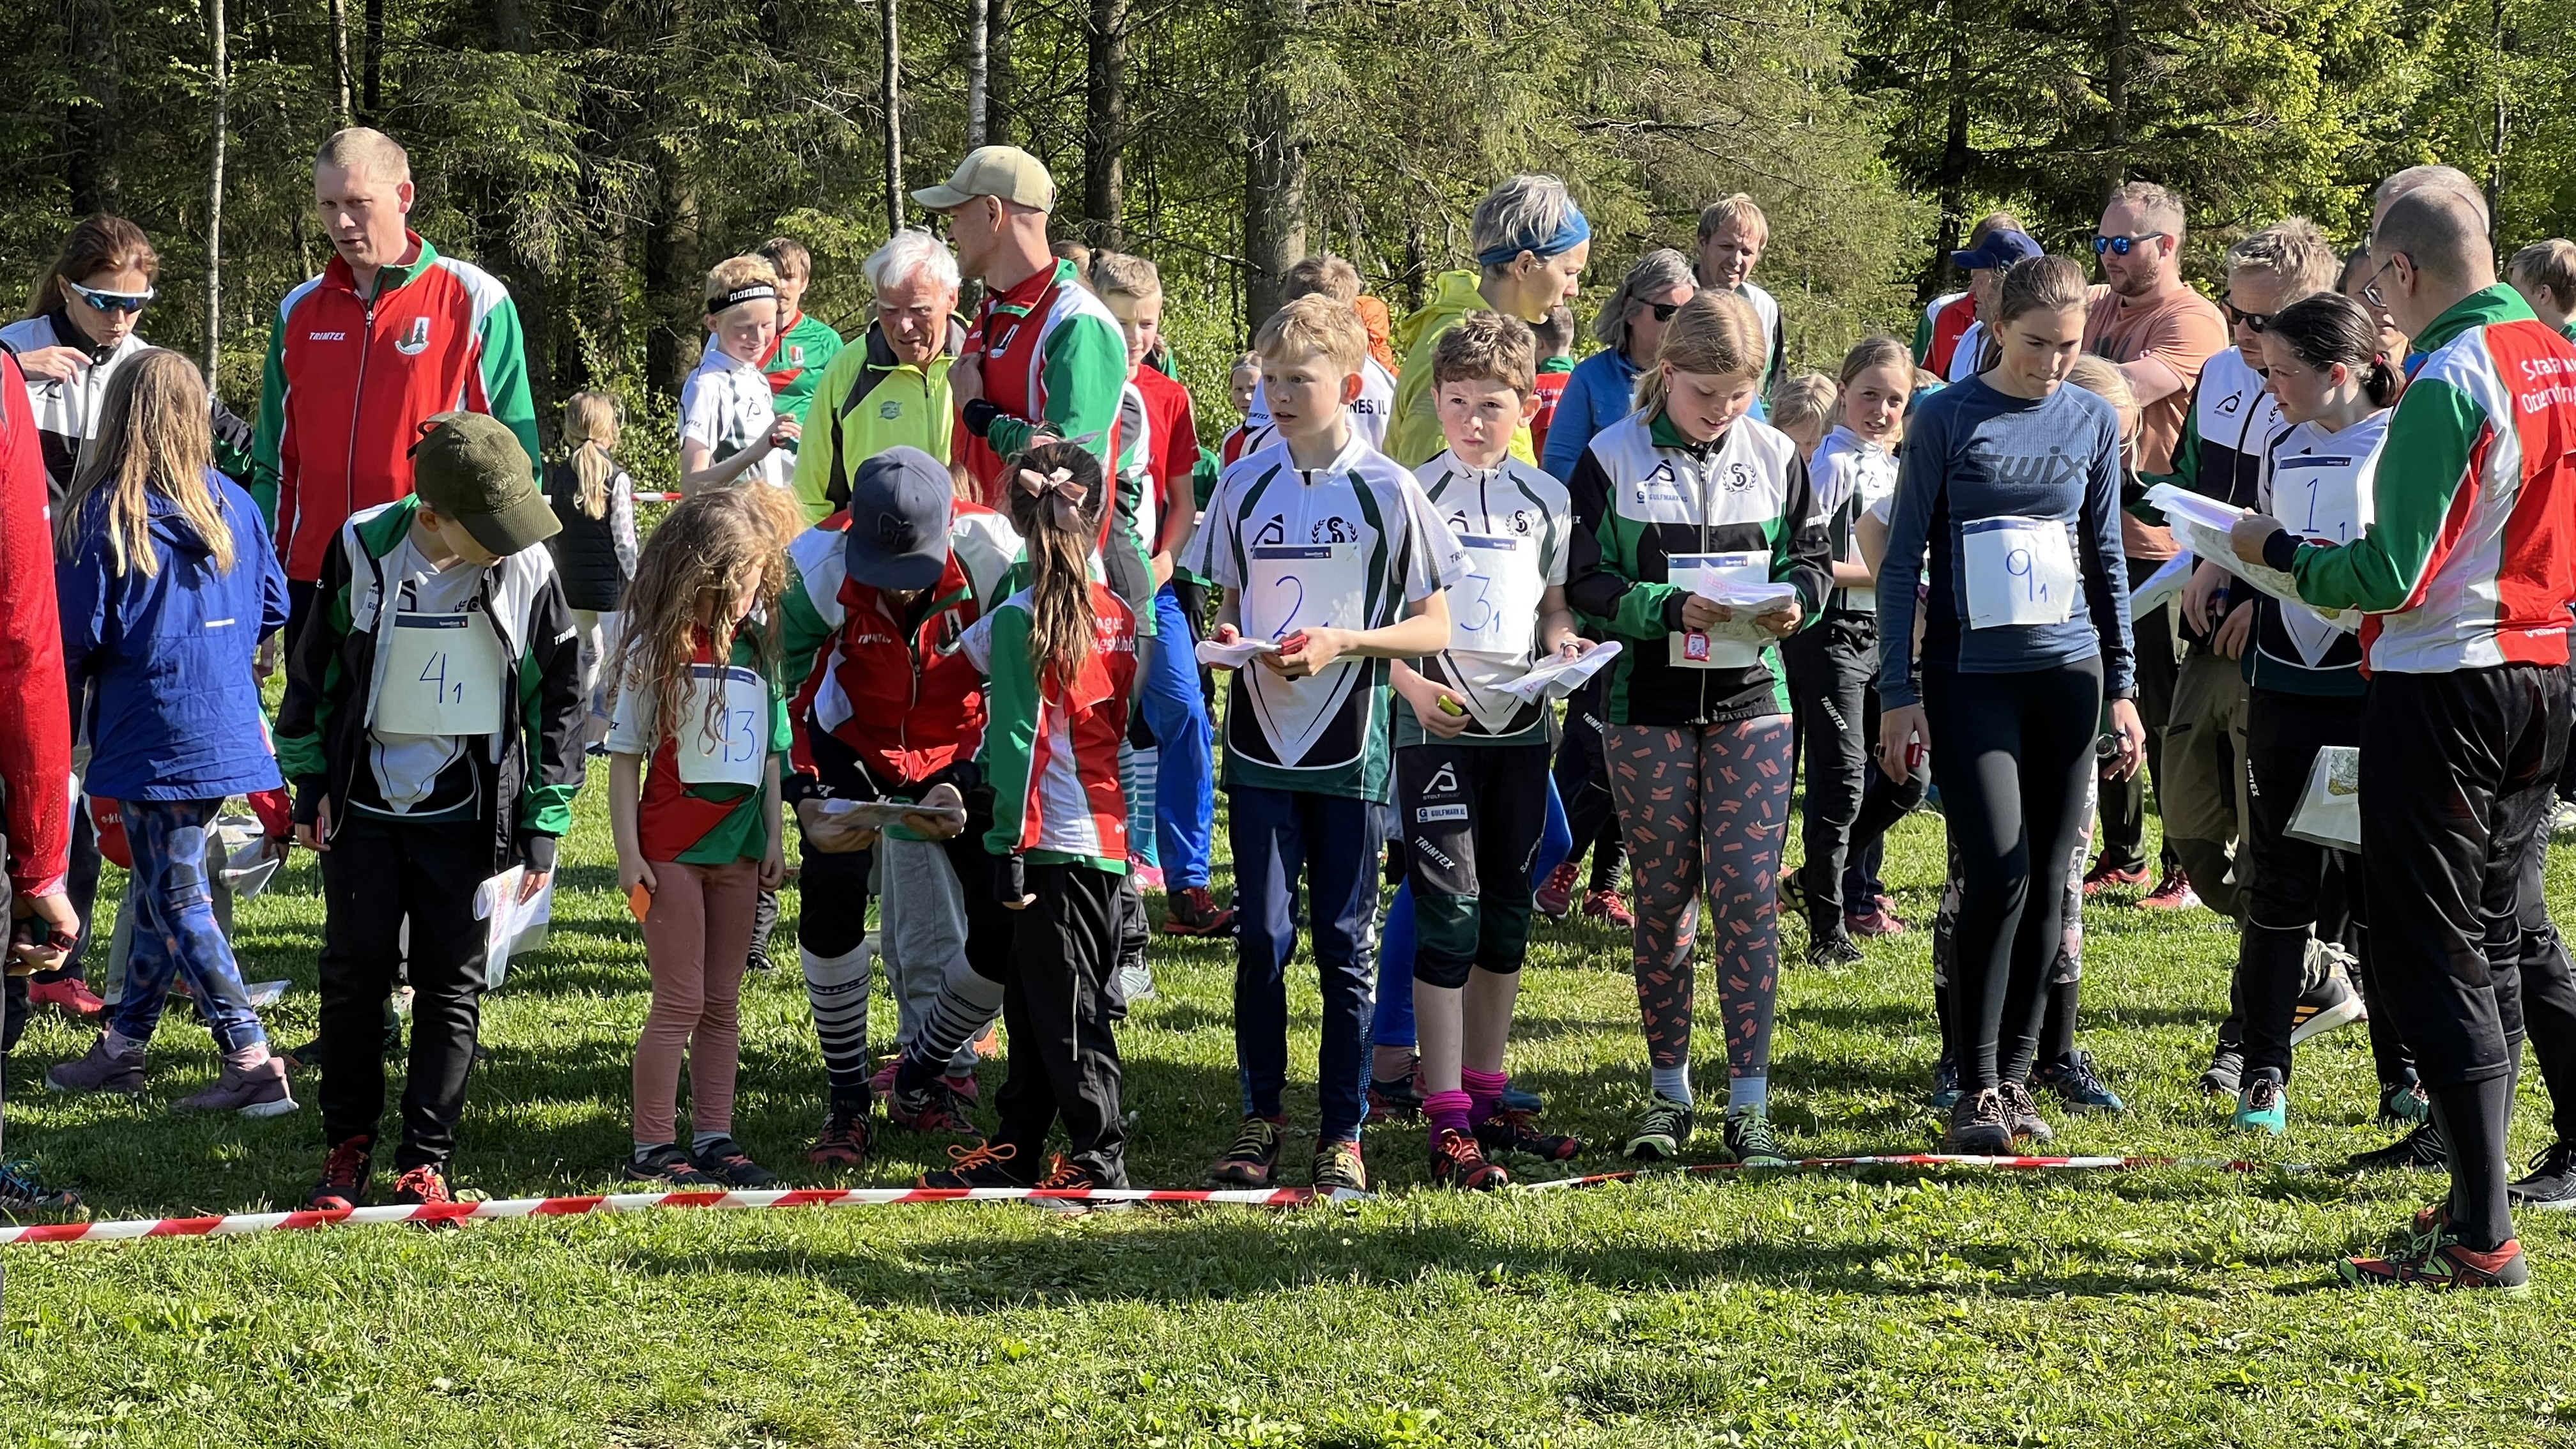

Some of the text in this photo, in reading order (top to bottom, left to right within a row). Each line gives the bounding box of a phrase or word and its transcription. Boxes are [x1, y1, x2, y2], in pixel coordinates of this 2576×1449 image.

[309, 332, 346, 341] TRIMTEX
[1347, 399, 1387, 415] NES IL
[2302, 478, 2346, 541] 1 1
[2006, 548, 2047, 603] 9 1
[1273, 575, 1303, 640] 2
[1460, 574, 1500, 633] 3 1
[419, 651, 462, 704] 4 1
[1820, 696, 1848, 732] TRIMTEX
[1414, 835, 1456, 870] TRIMTEX
